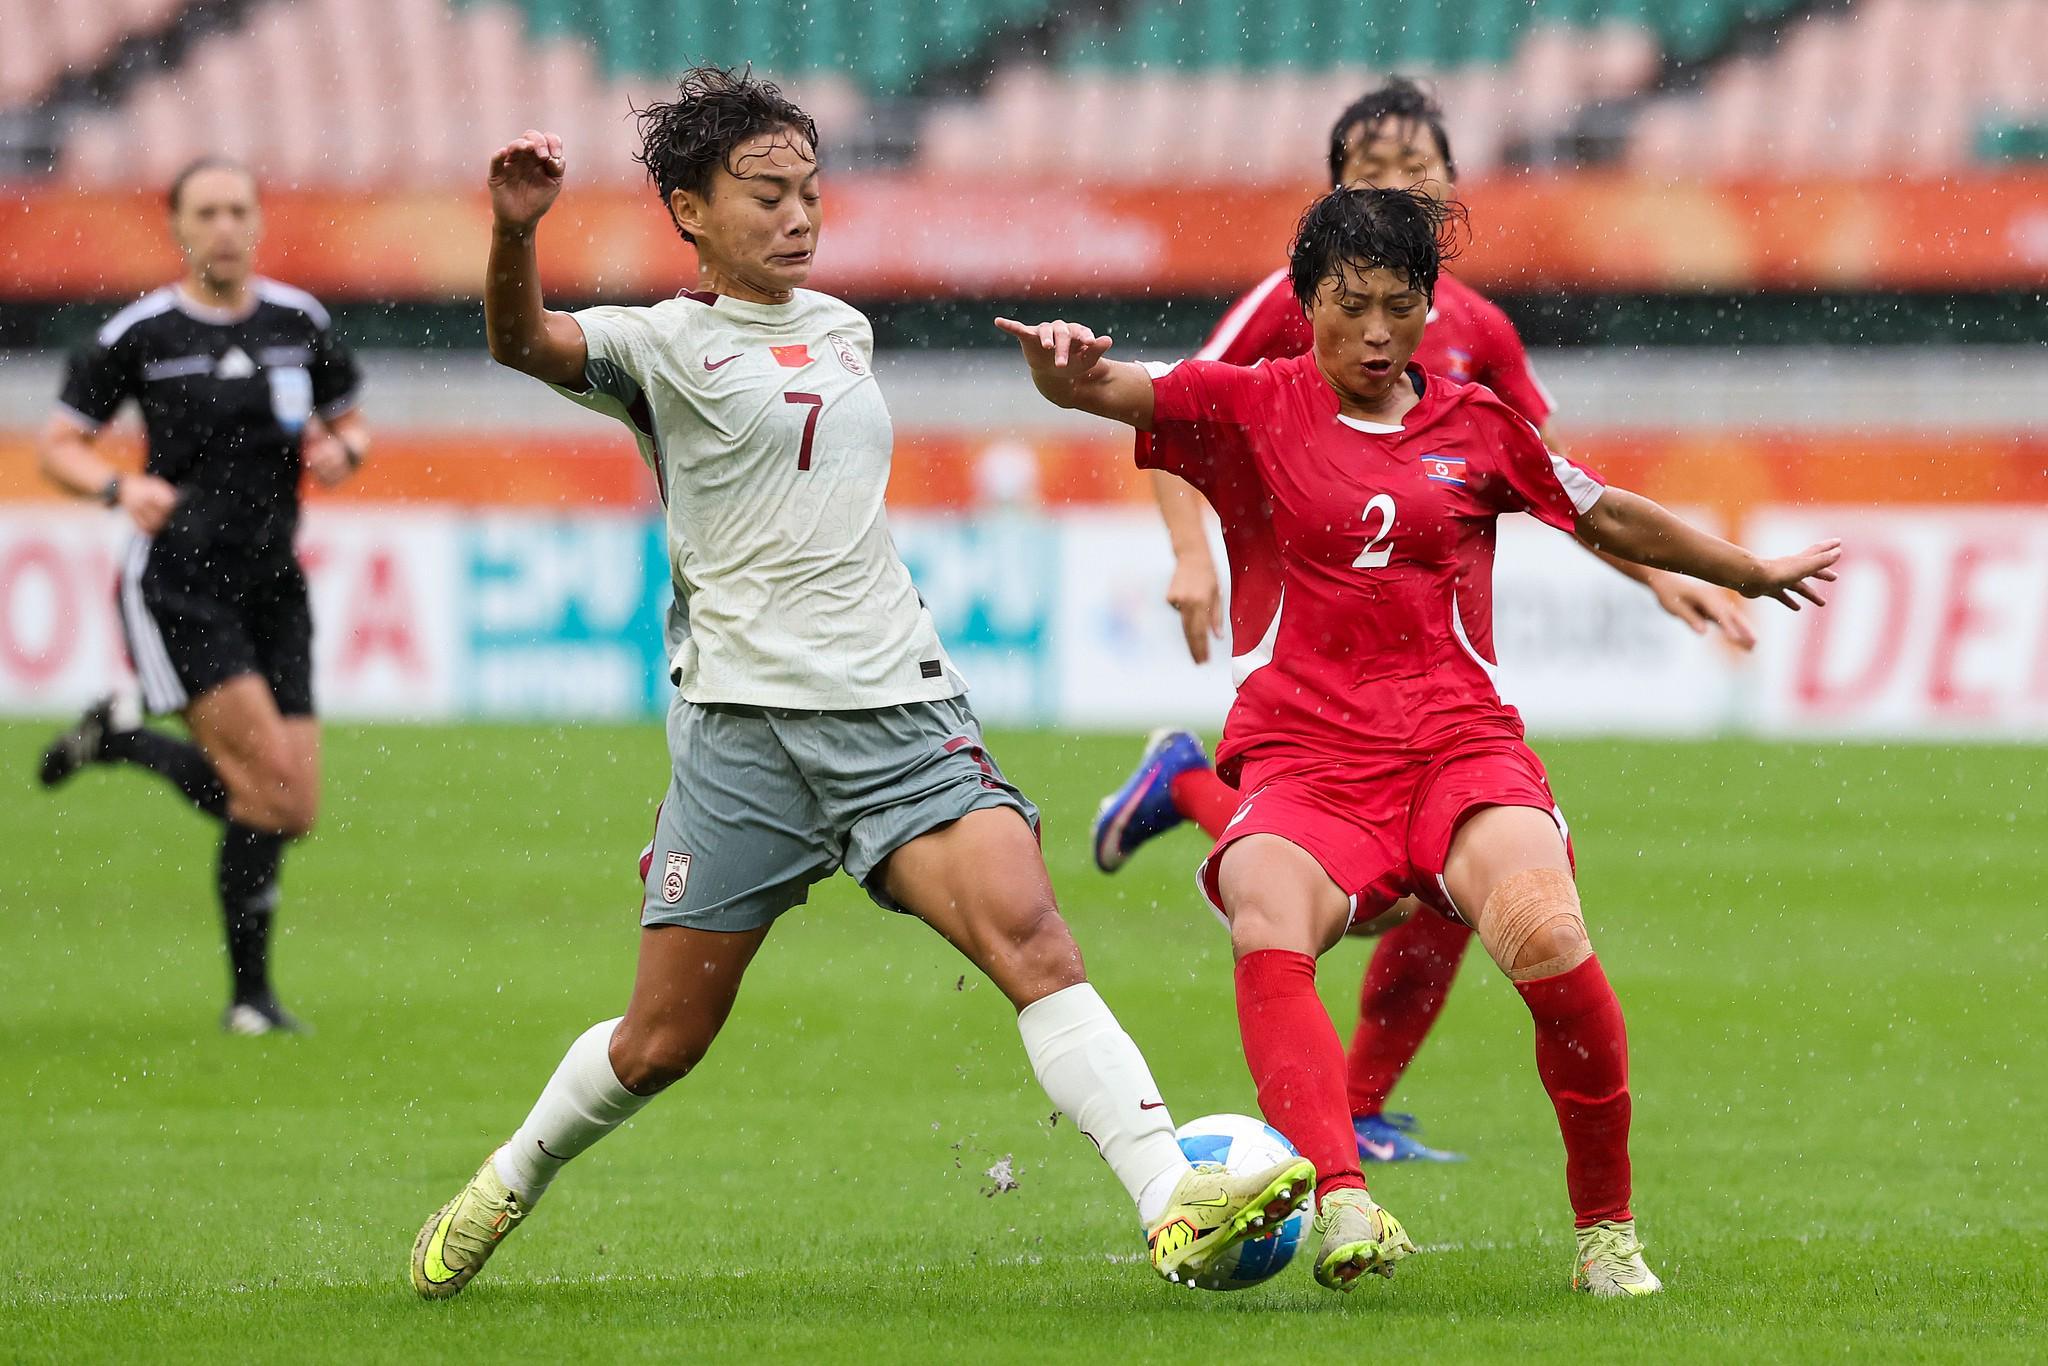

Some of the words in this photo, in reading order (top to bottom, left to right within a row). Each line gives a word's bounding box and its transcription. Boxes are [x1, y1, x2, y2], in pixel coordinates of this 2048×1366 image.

[783, 391, 824, 471] 7
[1352, 493, 1396, 568] 2
[1796, 542, 2048, 711] DE
